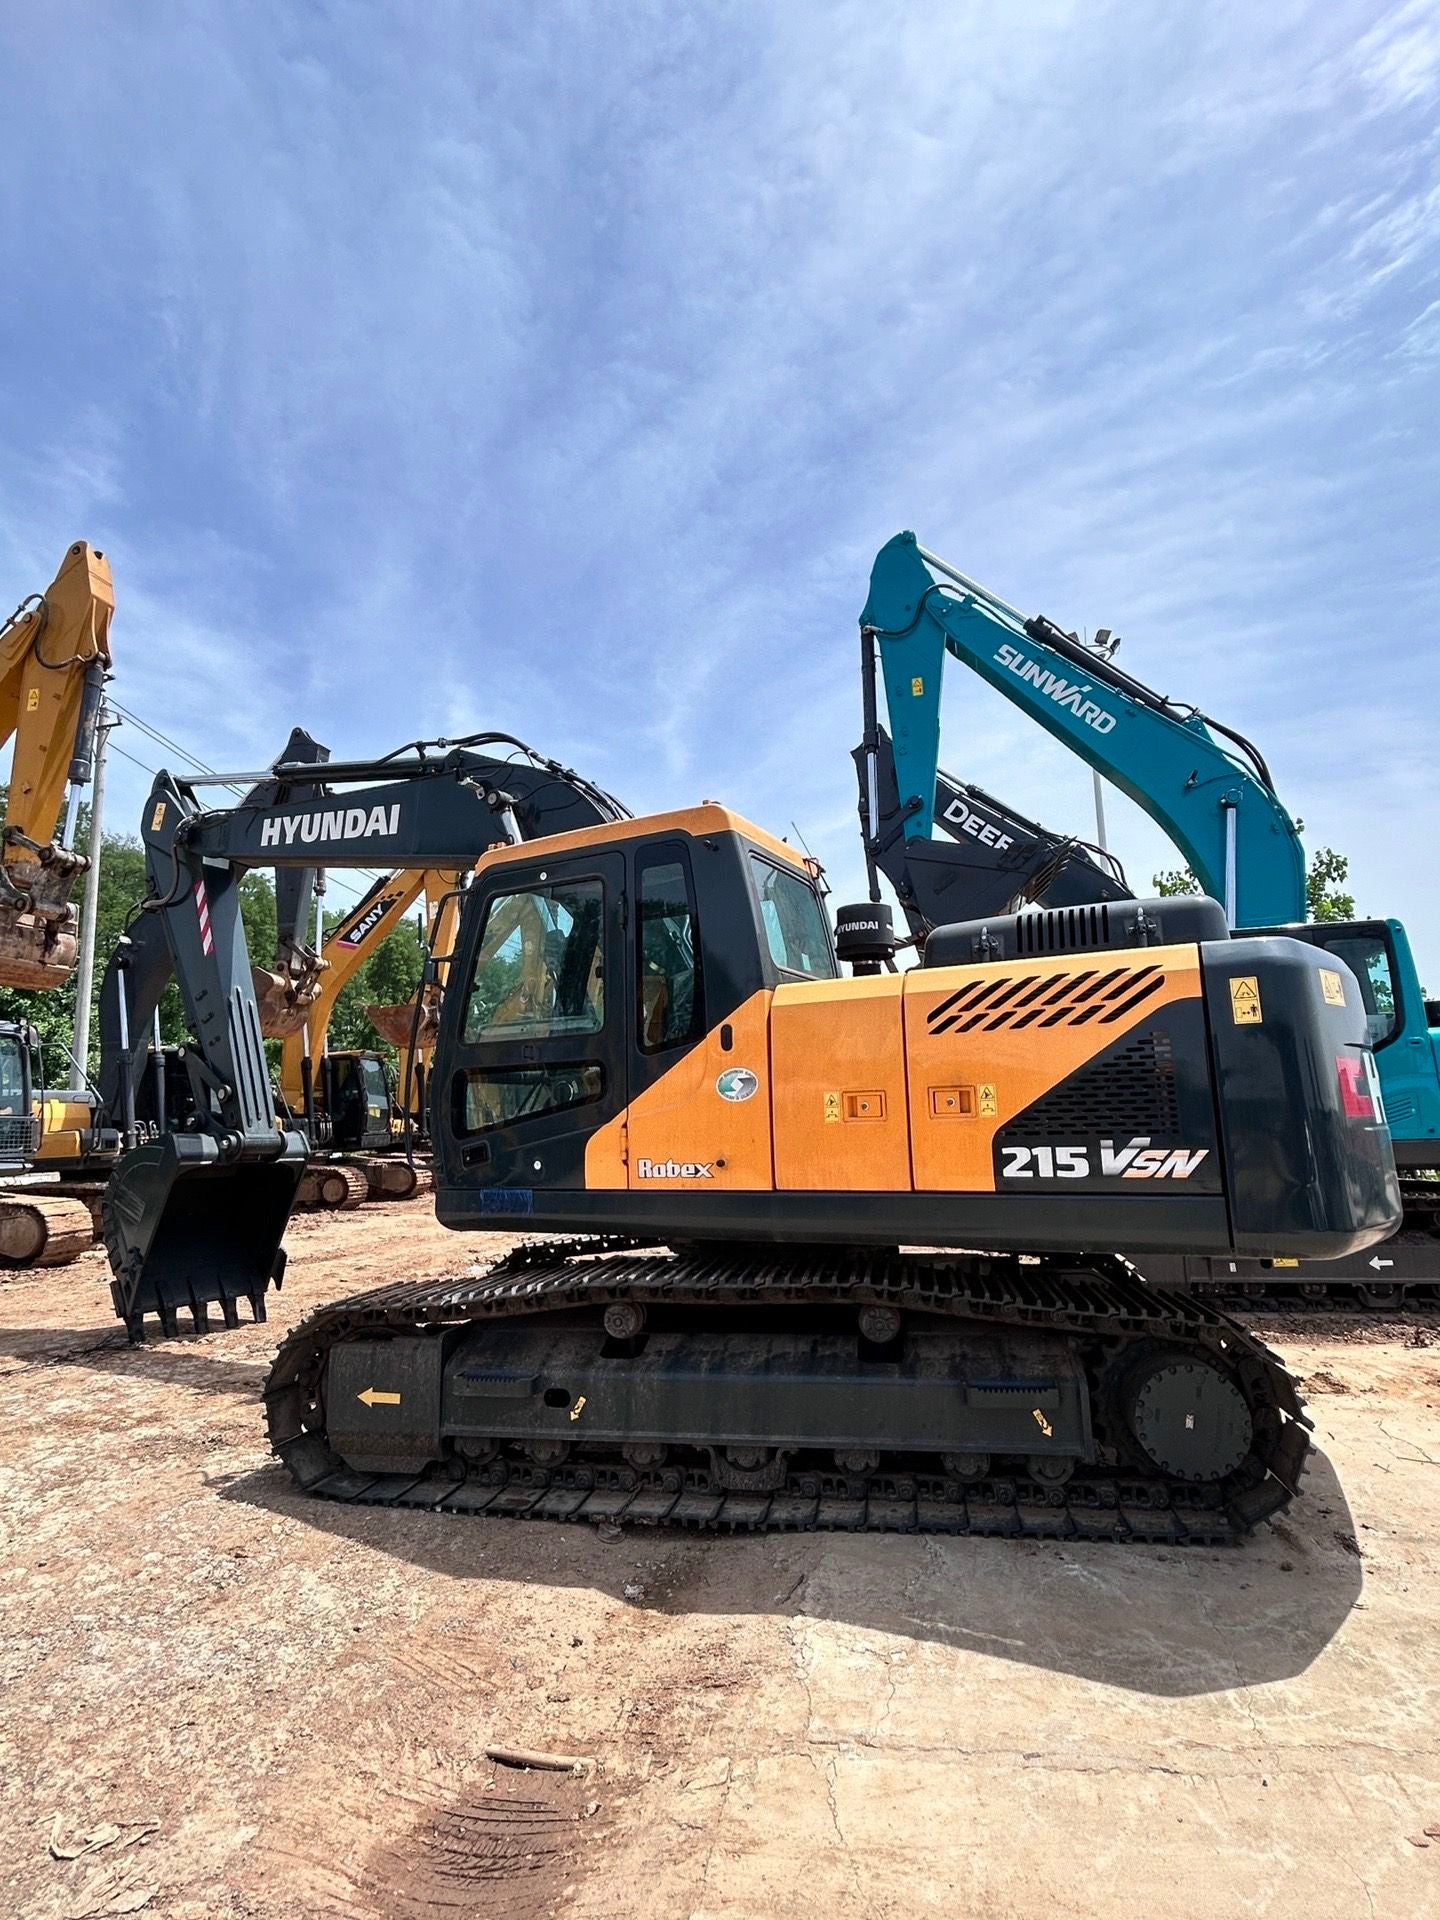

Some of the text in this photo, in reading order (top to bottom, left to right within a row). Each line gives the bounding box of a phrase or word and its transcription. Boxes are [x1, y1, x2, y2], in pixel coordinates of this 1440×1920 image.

[993, 643, 1117, 734] SUNWARD
[260, 803, 401, 847] HYUNDAI
[350, 903, 383, 943] SANY
[637, 1157, 715, 1178] Robex
[1001, 1146, 1090, 1178] 215
